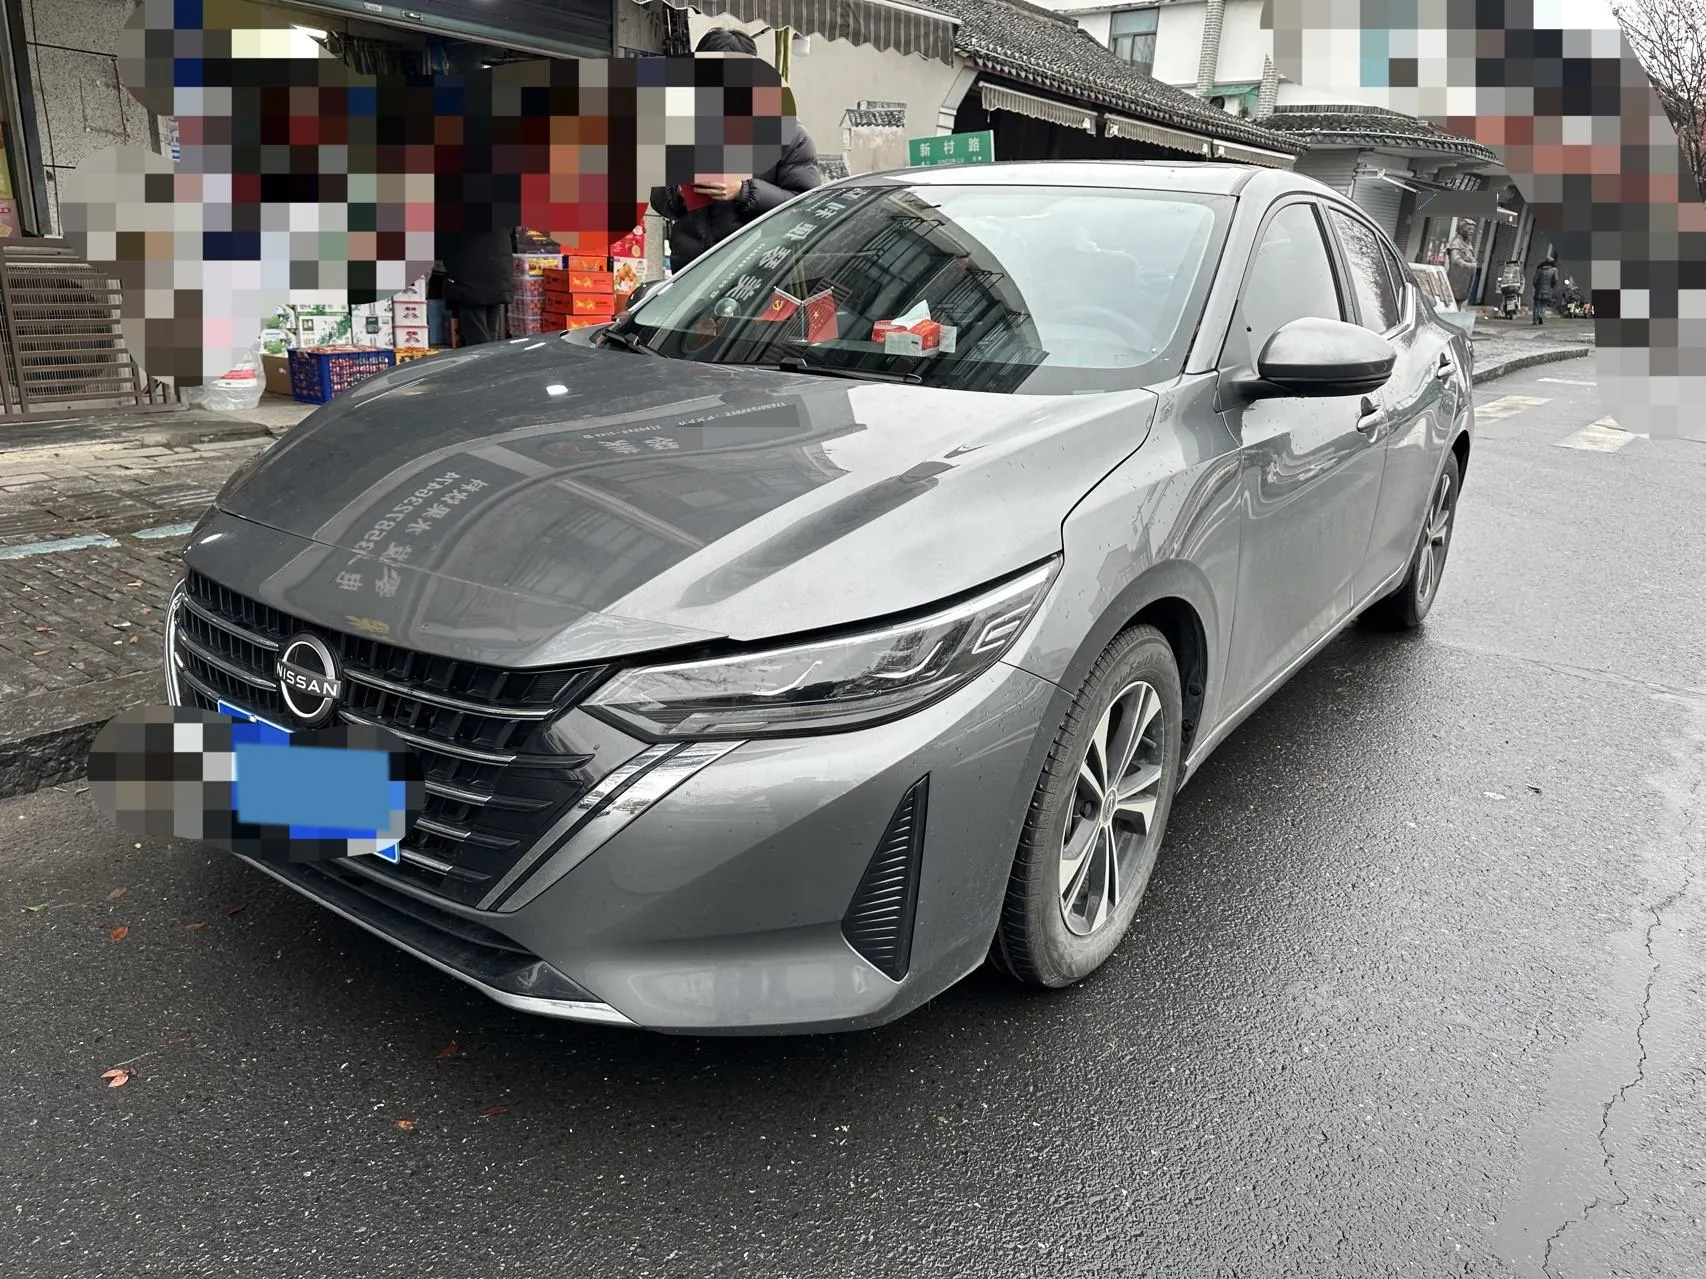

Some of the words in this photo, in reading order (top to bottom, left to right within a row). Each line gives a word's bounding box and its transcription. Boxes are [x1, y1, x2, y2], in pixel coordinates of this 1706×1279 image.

[920, 137, 980, 157] 新村路
[276, 661, 338, 697] NISSAN
